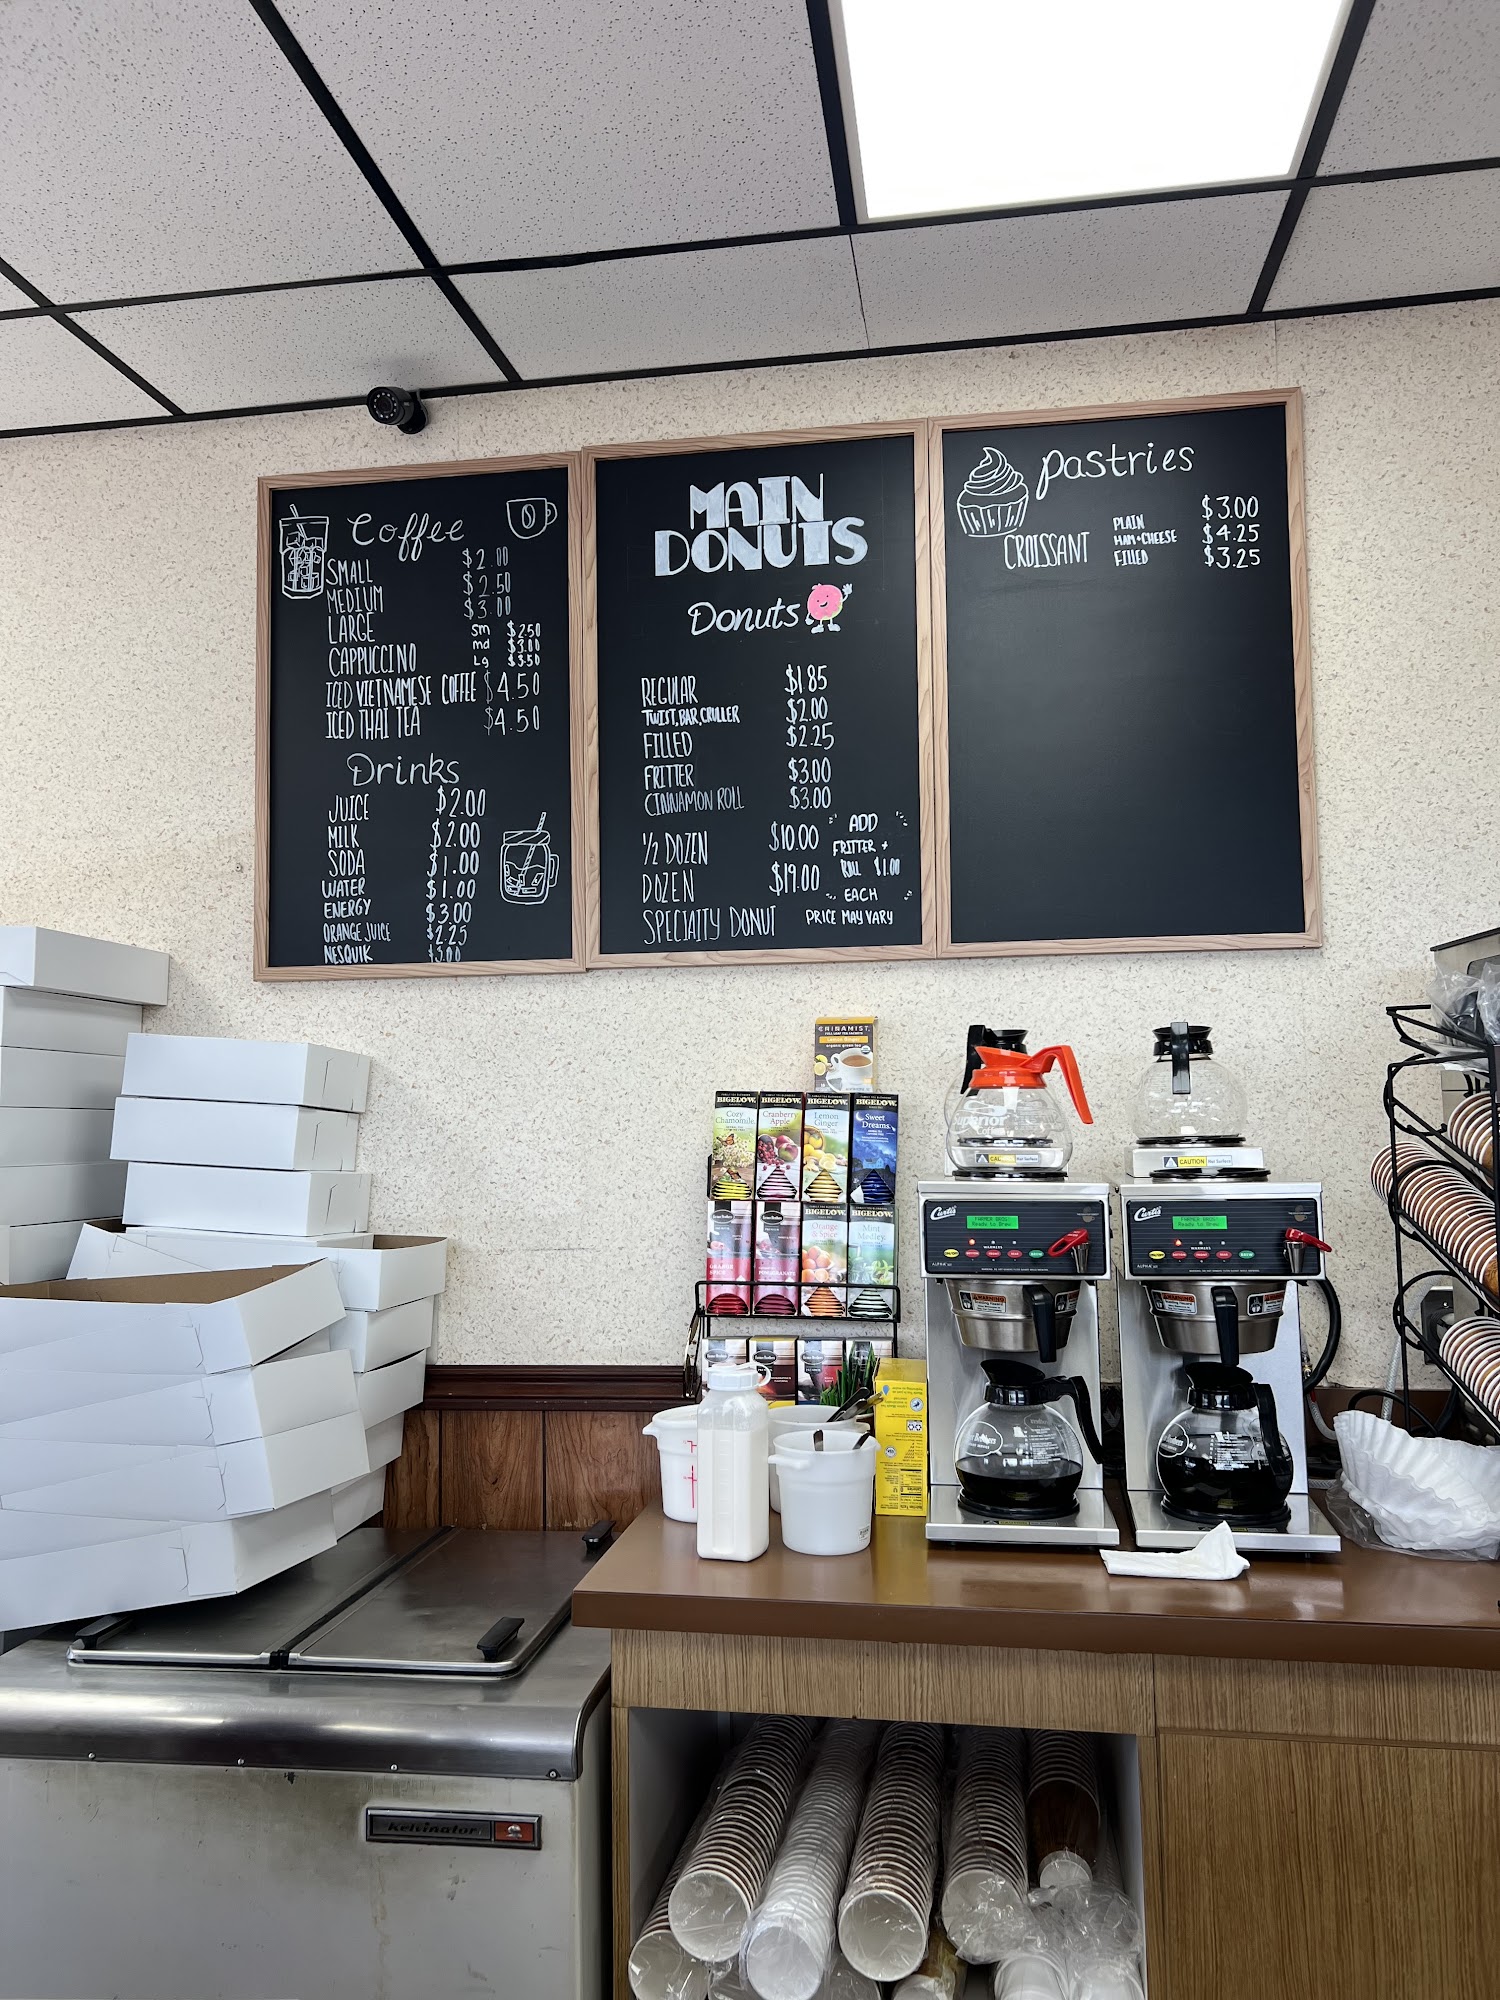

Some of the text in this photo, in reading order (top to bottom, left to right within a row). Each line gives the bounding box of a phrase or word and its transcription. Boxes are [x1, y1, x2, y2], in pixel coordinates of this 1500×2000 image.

[689, 472, 824, 530] MAIN
[1113, 494, 1258, 531] PLAIN $3.00
[347, 513, 464, 562] Coffee
[655, 516, 868, 577] DONUTS
[1202, 523, 1260, 544] $4.25
[1004, 531, 1260, 569] CROISSANT FILLED $3.25
[326, 546, 508, 586] SMALL $2.00
[326, 571, 510, 616] MEDIUM $2.50
[328, 596, 511, 644] LARGE $3.00
[507, 620, 540, 639] $2.50
[688, 598, 800, 635] Donuts
[329, 642, 416, 677] CAPPUCCINO
[508, 653, 540, 667] $3.50
[508, 637, 540, 655] $3.00
[326, 670, 539, 709] ICED VIETNAMESE COFFEE $4.50
[641, 664, 827, 707] REGULAR $1.85
[325, 704, 539, 740] ICED THAI TEA $4.50
[786, 696, 829, 725] $2.00
[643, 721, 834, 759] FILLED $2.25
[347, 753, 459, 786] Drinks
[644, 757, 831, 790] FRITTER $3.00
[329, 785, 485, 823] JUICE $2.00
[645, 786, 831, 816] CINNAMON ROLL $3.00
[328, 818, 480, 852] MILK $2.00
[849, 813, 878, 832] ADD
[665, 831, 707, 865] DOZEN
[769, 821, 819, 851] $10.00
[833, 839, 876, 856] FRITTER
[328, 849, 479, 878] SODA $1.00
[840, 856, 900, 878] ROLL $1.00
[322, 877, 475, 900] WATER $1.00
[643, 861, 819, 903] DOZEN $19.00
[844, 888, 878, 902] EACH
[324, 898, 471, 925] ENERGY $3.00
[730, 905, 776, 937] DONUT
[806, 909, 893, 925] PRICE MAY VARY
[323, 922, 467, 947] ORANGE JUICE $2.25
[324, 944, 373, 964] NESQUIK
[726, 1110, 744, 1118] Cozy
[763, 1110, 798, 1118] Cranberry
[770, 1118, 790, 1126] Apple
[814, 1112, 839, 1120] Lemon
[814, 1119, 838, 1128] Ginger
[862, 1121, 890, 1129] Dreams
[812, 1222, 838, 1231] Orange
[930, 1206, 956, 1221] Curtis
[1134, 1207, 1161, 1221] Curtis
[820, 1231, 838, 1239] Spice
[857, 1233, 884, 1242] Medley
